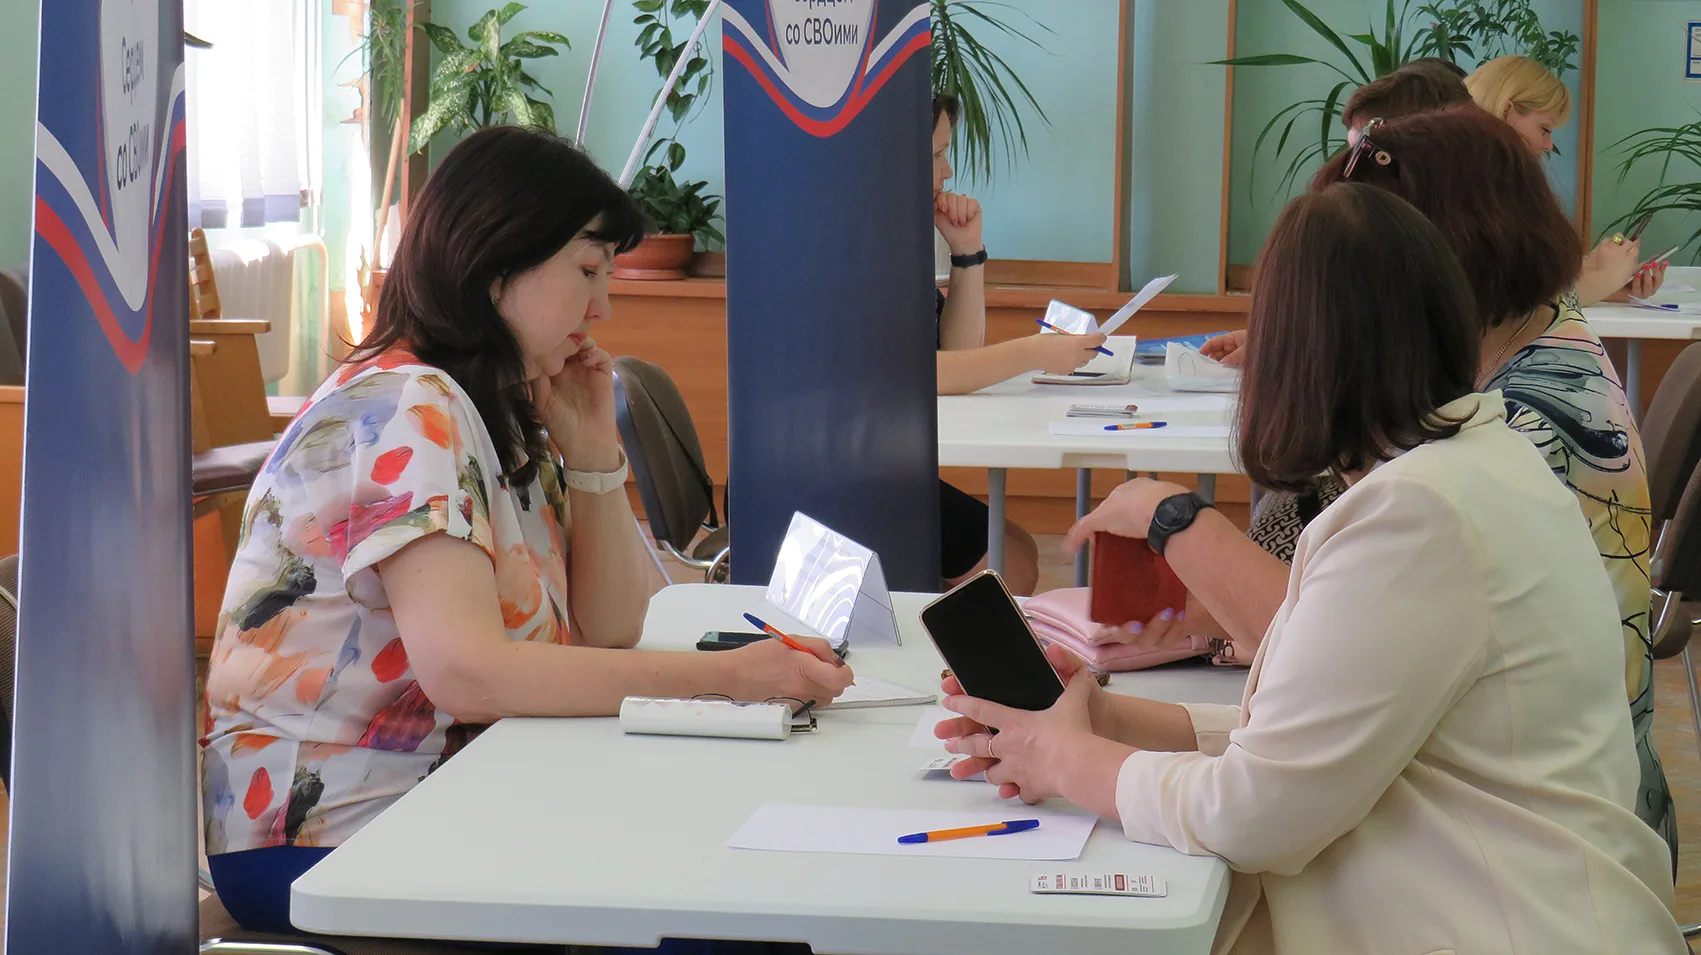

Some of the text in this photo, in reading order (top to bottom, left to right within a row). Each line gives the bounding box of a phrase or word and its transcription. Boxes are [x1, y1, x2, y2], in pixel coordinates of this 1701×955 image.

[785, 18, 858, 45] со СВОими
[116, 144, 127, 191] со
